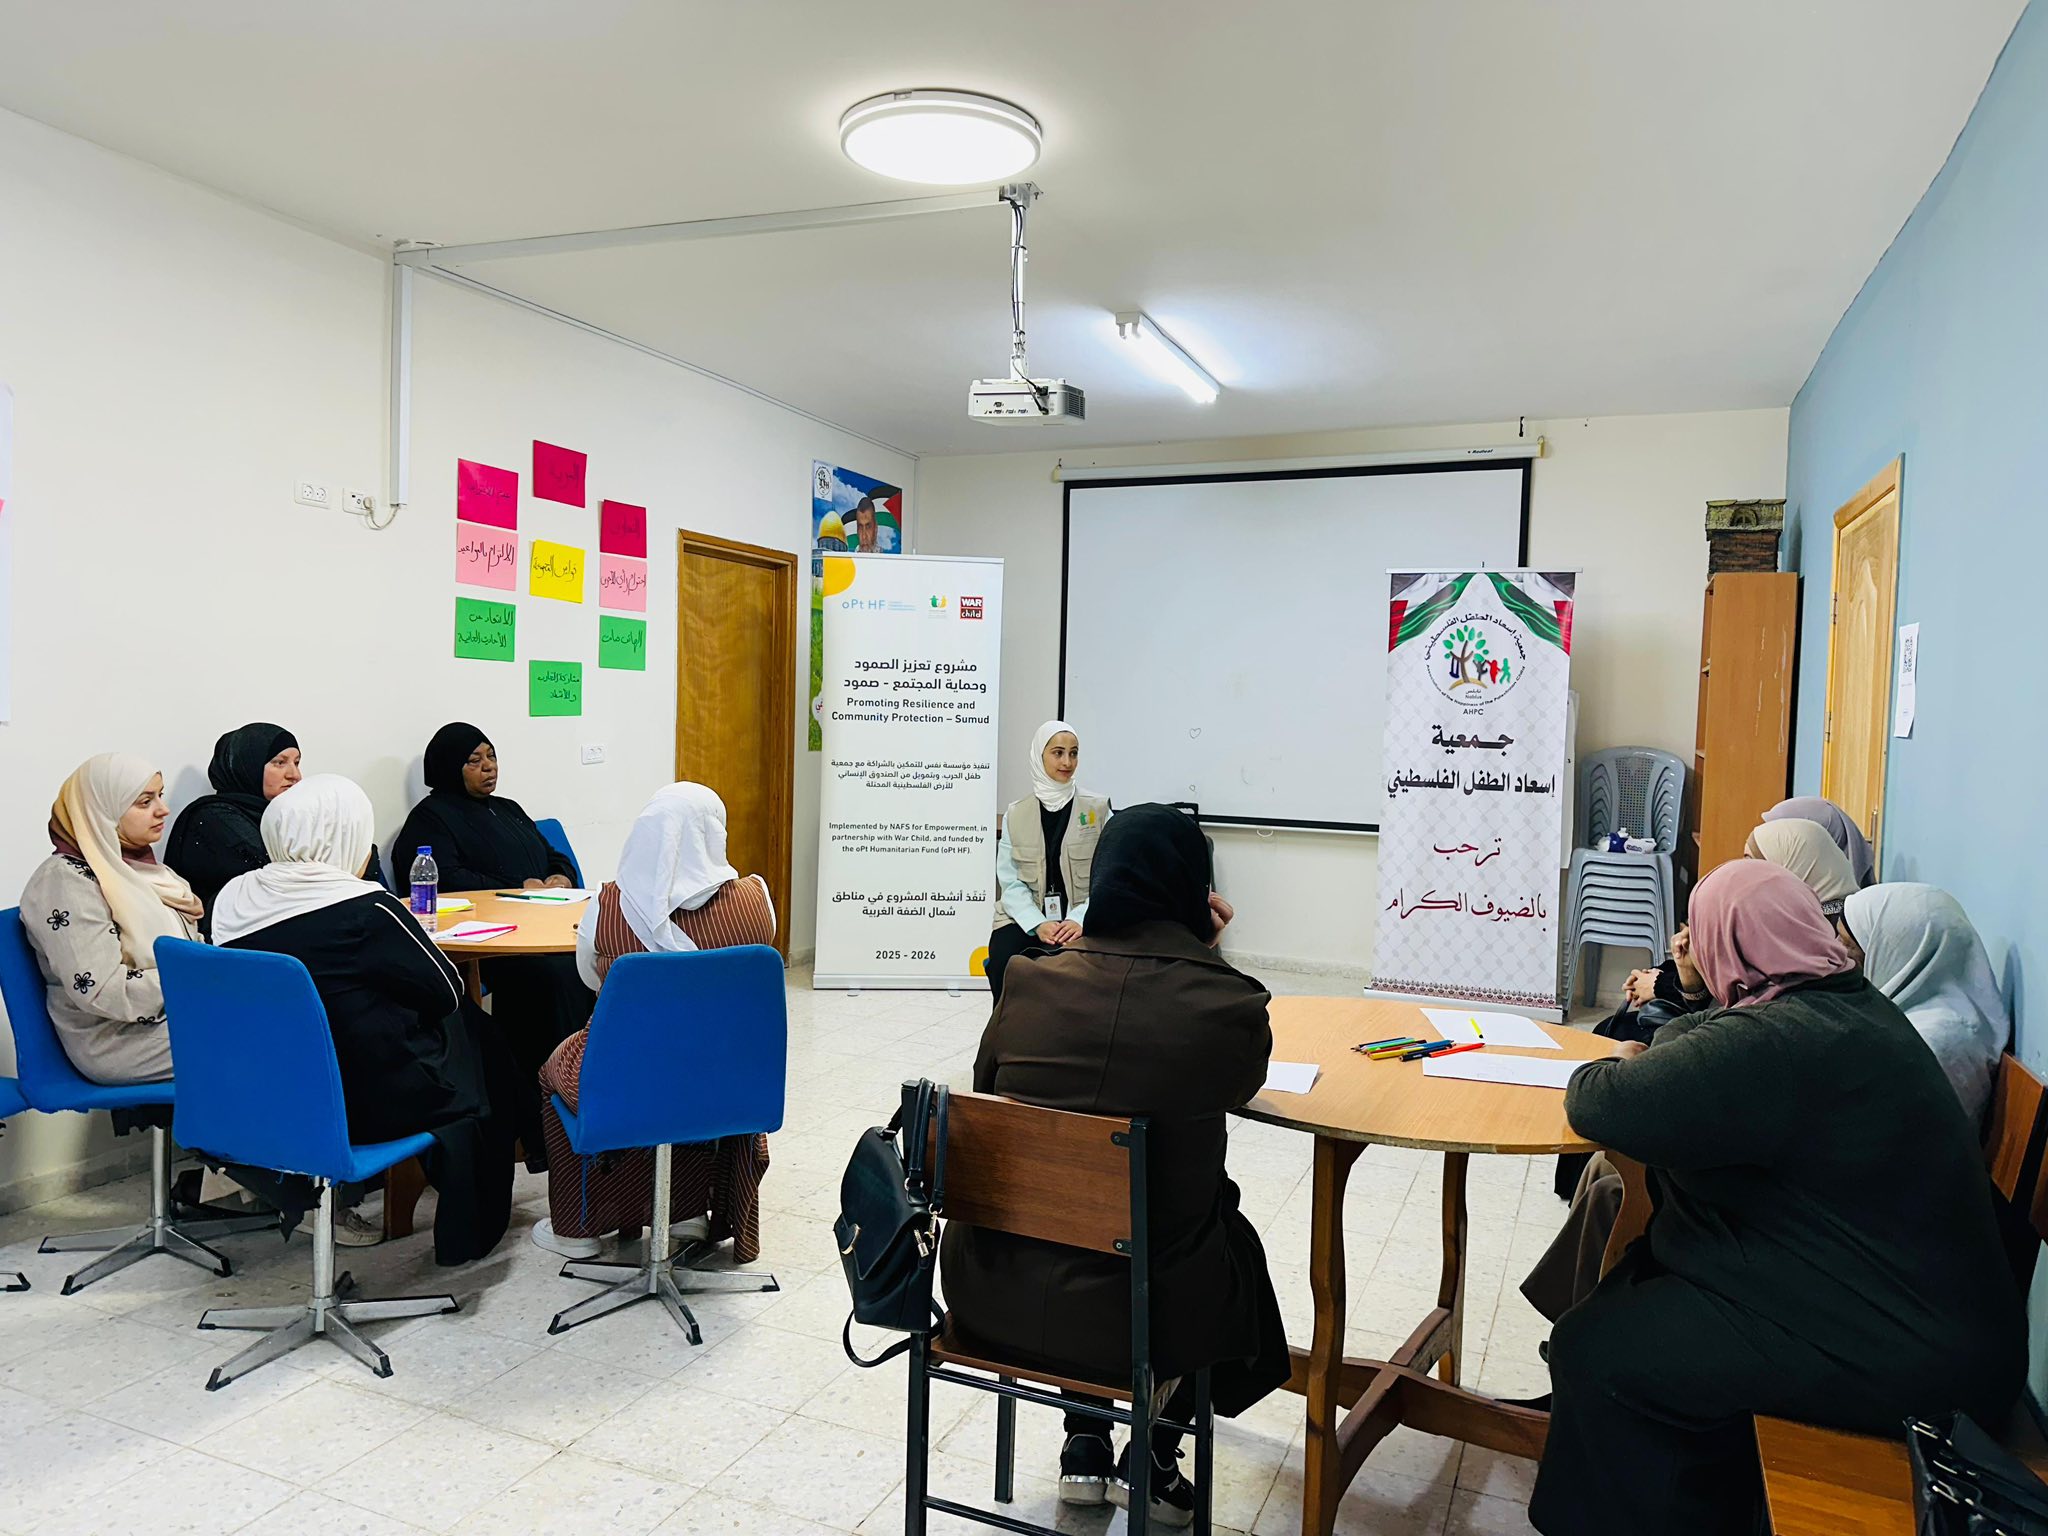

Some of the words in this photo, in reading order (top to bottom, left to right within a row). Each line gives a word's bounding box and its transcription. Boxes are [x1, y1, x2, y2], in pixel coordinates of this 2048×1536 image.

[458, 541, 487, 562] بالمواعيد
[488, 542, 514, 573] الالتزام
[554, 560, 576, 582] قوانين
[842, 599, 864, 610] oPt
[868, 600, 886, 610] HF
[962, 598, 982, 607] WAR
[485, 608, 513, 626] الابتعاد
[961, 608, 981, 618] child
[1460, 613, 1492, 623] الطفل
[602, 628, 620, 642] صامت
[621, 630, 642, 653] الهاتف
[855, 659, 899, 672] الصمود
[902, 660, 931, 673] تعزيز
[935, 659, 977, 673] مشروع
[844, 679, 879, 688] صمود
[892, 679, 941, 692] المجتمع
[946, 679, 987, 693] وحماية
[847, 698, 899, 709] Promoting
[902, 699, 954, 709] Resilience
[957, 701, 976, 709] and
[832, 712, 889, 723] Community
[892, 713, 944, 723] Protection
[955, 715, 989, 724] Sumud
[1432, 724, 1514, 756] جمعية
[866, 760, 895, 768] بالشراكة
[897, 761, 923, 769] للتمكين
[943, 762, 971, 770] مؤسسة
[838, 770, 867, 779] الإنساني
[868, 771, 898, 779] الصندوق
[912, 772, 940, 780] وبتمويل
[892, 782, 932, 790] الفلسطينية
[933, 782, 953, 790] للأرض
[1387, 768, 1460, 798] الفلسطيني
[1463, 769, 1510, 794] الطفل
[1514, 773, 1556, 798] إسعاد
[879, 823, 888, 831] by
[832, 834, 875, 842] partnership
[941, 846, 956, 854] (oPt
[1433, 838, 1502, 866] ترحب
[832, 892, 865, 903] مناطق
[868, 892, 883, 904] في
[886, 891, 927, 903] المشروع
[930, 890, 963, 902] أنشطة
[1385, 888, 1468, 920] الكرام
[862, 906, 894, 918] الغربية
[897, 906, 925, 916] الضفة
[928, 906, 956, 918] شمال
[1470, 892, 1547, 932] بالضيوف
[875, 950, 901, 959] 2025
[911, 951, 936, 960] 2026
